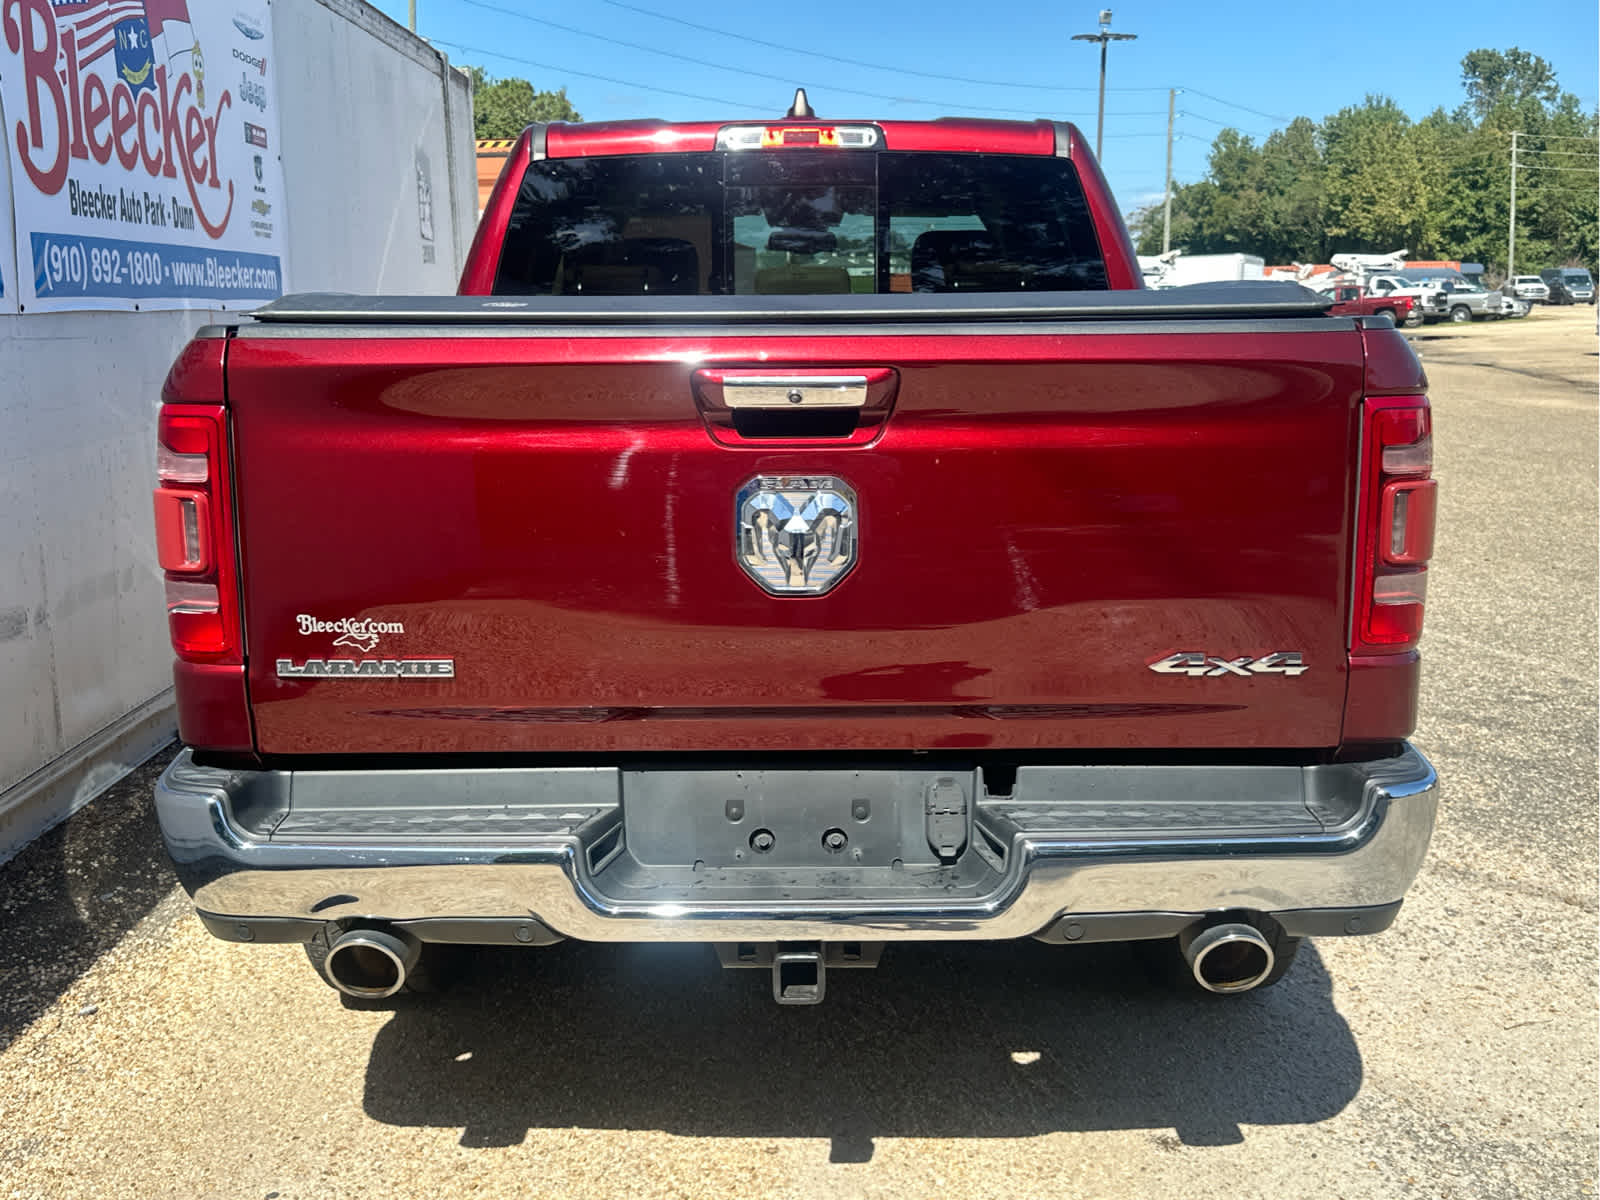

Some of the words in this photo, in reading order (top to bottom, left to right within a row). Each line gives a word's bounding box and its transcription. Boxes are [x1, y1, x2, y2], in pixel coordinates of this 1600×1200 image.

[232, 48, 262, 68] DODGE
[68, 179, 117, 218] Bleecker
[120, 189, 142, 225] Auto
[144, 192, 167, 226] Park
[173, 196, 194, 231] Dunn
[44, 240, 88, 290] (910)
[91, 250, 162, 286] 892-1800
[172, 257, 278, 292] www.Bleecker.com
[276, 658, 454, 678] LARAMIE
[1148, 652, 1309, 676] 4x4
